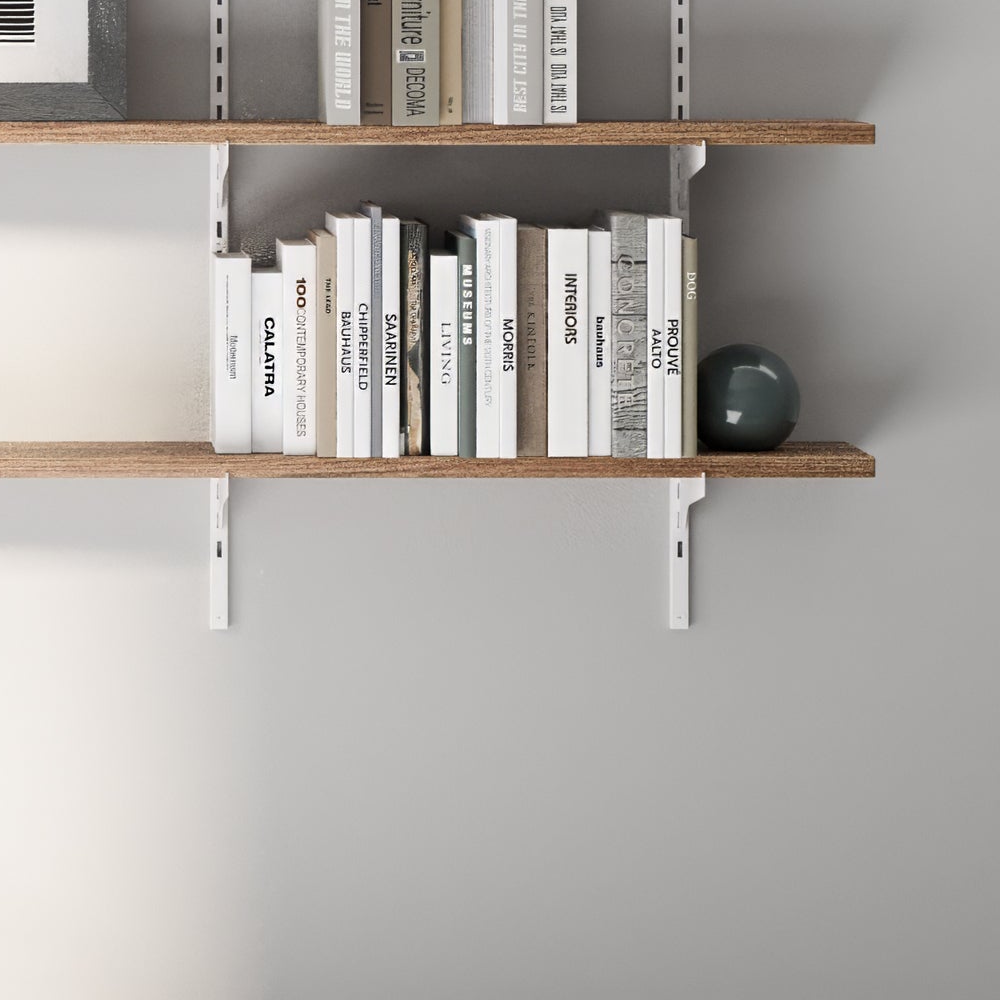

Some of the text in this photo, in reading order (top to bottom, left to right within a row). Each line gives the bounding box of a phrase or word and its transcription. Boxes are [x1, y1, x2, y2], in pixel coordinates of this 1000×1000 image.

[334, 14, 352, 48] THE
[550, 26, 567, 46] THAT
[550, 47, 567, 56] IS
[406, 67, 426, 117] DECOMA
[550, 83, 567, 103] THAT
[550, 105, 567, 114] IS
[462, 264, 473, 346] MUSEUMS
[564, 273, 578, 345] INTERIORS
[686, 271, 697, 300] DOG
[264, 317, 276, 397] CALATRA
[341, 311, 352, 374] BAUHAUS
[358, 302, 369, 391] CHIPPERFIELD
[385, 313, 397, 386] SAARINEN
[440, 322, 451, 385] LIVING
[502, 318, 515, 372] MORRIS
[595, 316, 605, 368] bauhaus
[651, 328, 662, 369] AALTO
[666, 319, 680, 376] PROUVÉ
[295, 395, 307, 438] HOUSES
